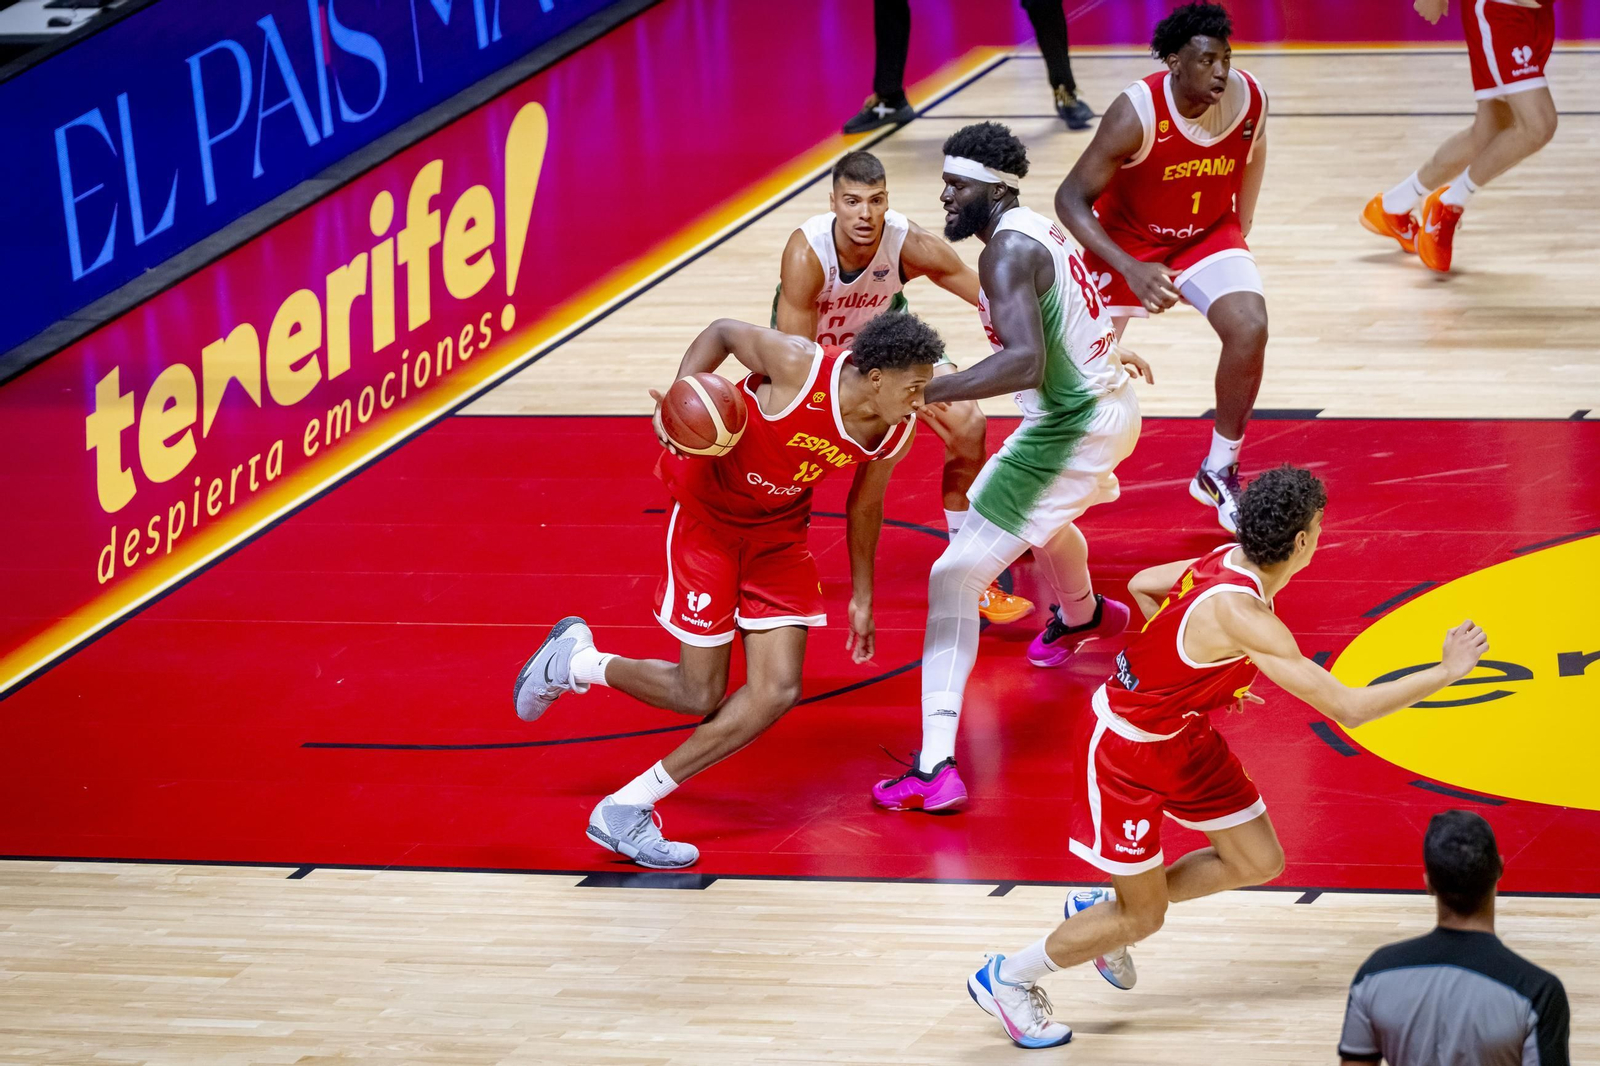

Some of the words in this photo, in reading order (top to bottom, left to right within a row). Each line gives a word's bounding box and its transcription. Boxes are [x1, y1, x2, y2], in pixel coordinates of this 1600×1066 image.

[54, 92, 178, 282] EL
[1162, 155, 1236, 181] ESPAÑA
[1191, 191, 1202, 214] 1
[86, 101, 548, 514] tenerife!
[97, 439, 283, 584] despierta
[303, 311, 492, 457] emociones
[793, 461, 823, 482] 13
